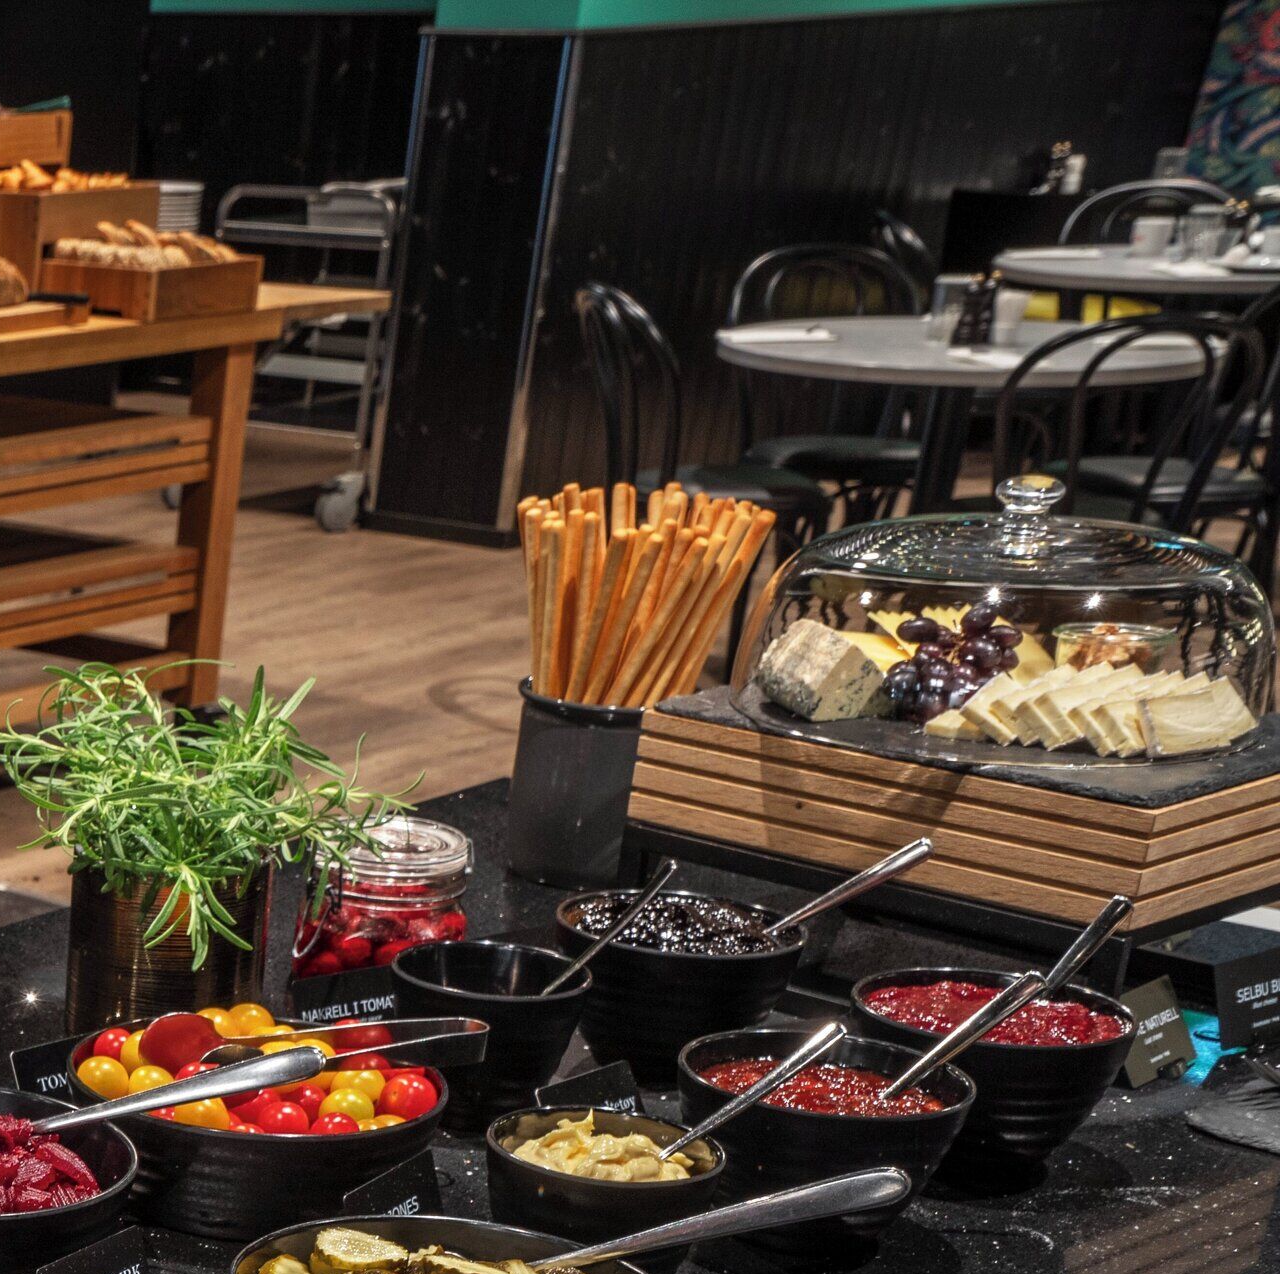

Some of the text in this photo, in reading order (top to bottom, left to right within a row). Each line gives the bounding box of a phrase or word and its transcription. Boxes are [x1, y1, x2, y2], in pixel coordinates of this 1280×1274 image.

[1236, 981, 1269, 1004] SELBU
[302, 1003, 351, 1022] MAKRELL
[353, 1001, 359, 1015] I
[1144, 1007, 1180, 1031] NATURELL
